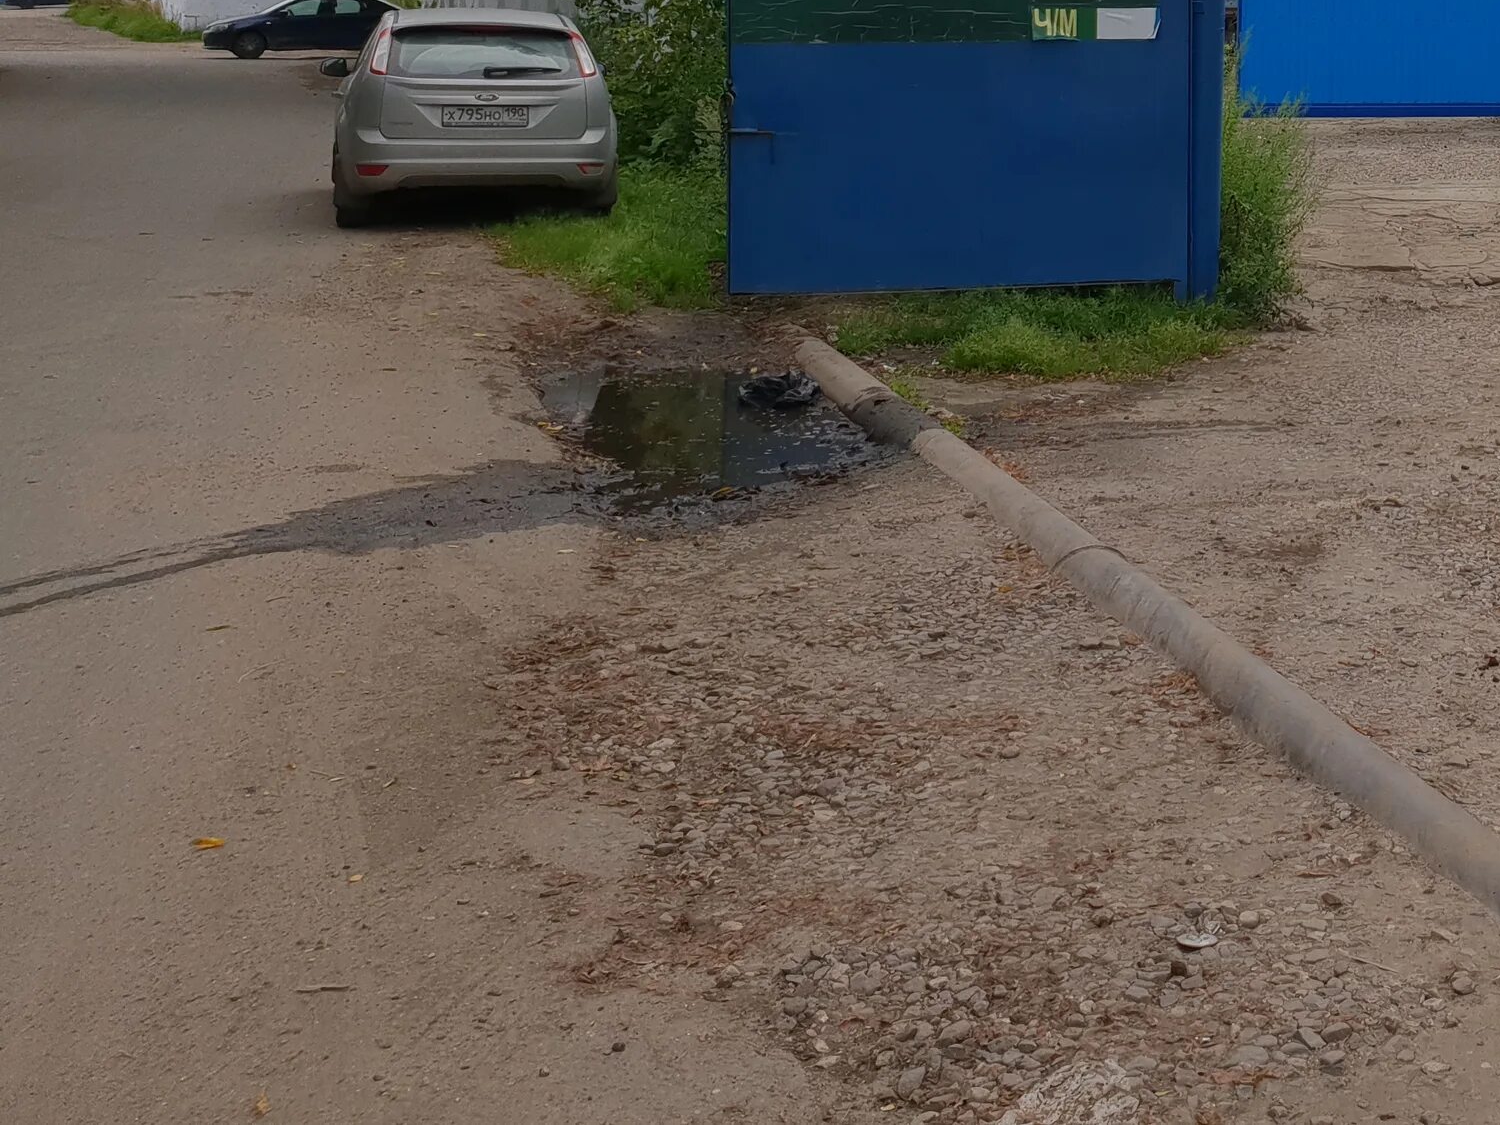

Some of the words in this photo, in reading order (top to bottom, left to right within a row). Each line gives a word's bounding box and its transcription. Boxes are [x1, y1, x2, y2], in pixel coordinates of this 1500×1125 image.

[1033, 7, 1078, 38] Ч/М
[447, 107, 502, 121] Х795НО
[504, 107, 524, 117] 190
